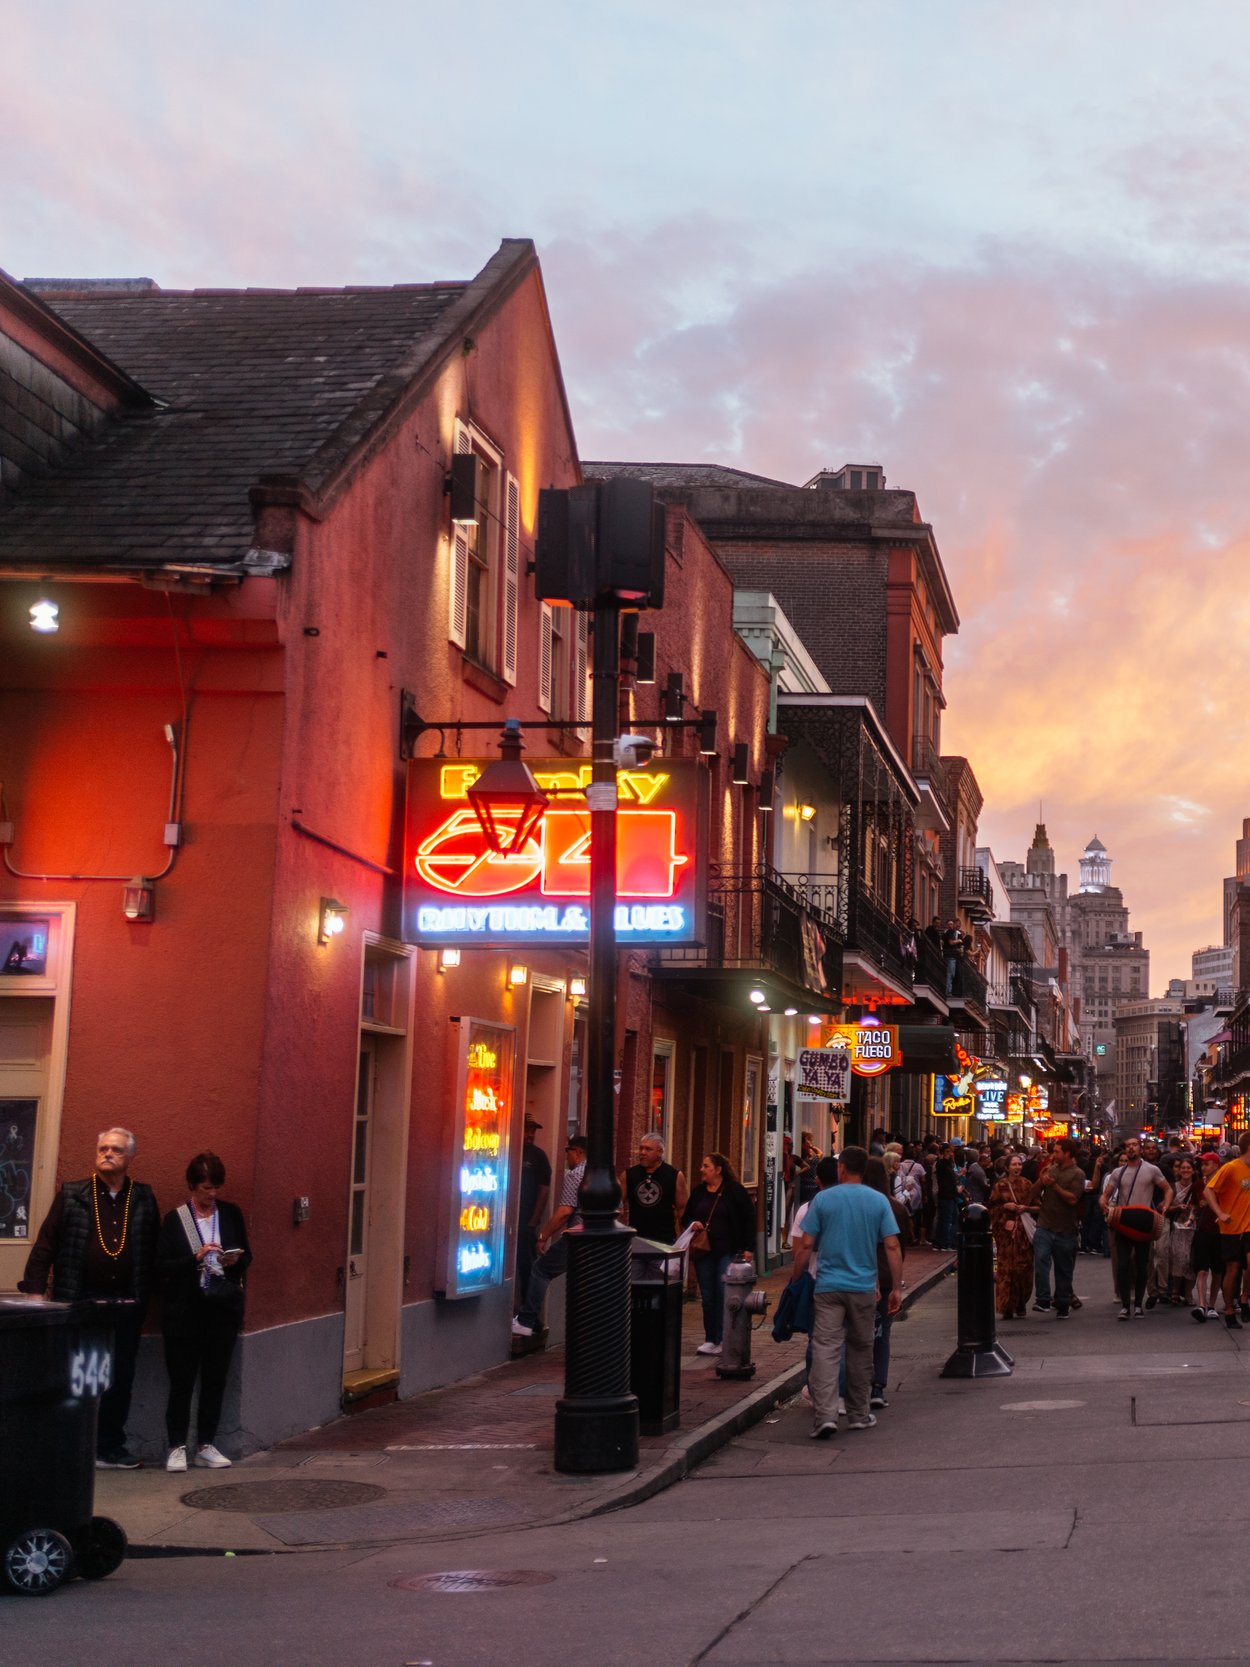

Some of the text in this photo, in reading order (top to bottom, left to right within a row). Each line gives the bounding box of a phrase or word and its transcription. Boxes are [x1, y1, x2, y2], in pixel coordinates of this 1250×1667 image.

[439, 765, 671, 804] Fnky
[418, 905, 685, 932] RHYTHM & LUES
[856, 1030, 891, 1045] TACO
[800, 1050, 849, 1072] GUMBO
[855, 1045, 892, 1058] FUEGO
[802, 1067, 842, 1089] YA YA
[979, 1091, 1004, 1102] LIVE
[463, 1127, 500, 1157] Balcony
[460, 1167, 498, 1195] Upstairs
[469, 1205, 489, 1231] Cold
[71, 1350, 111, 1397] 544
